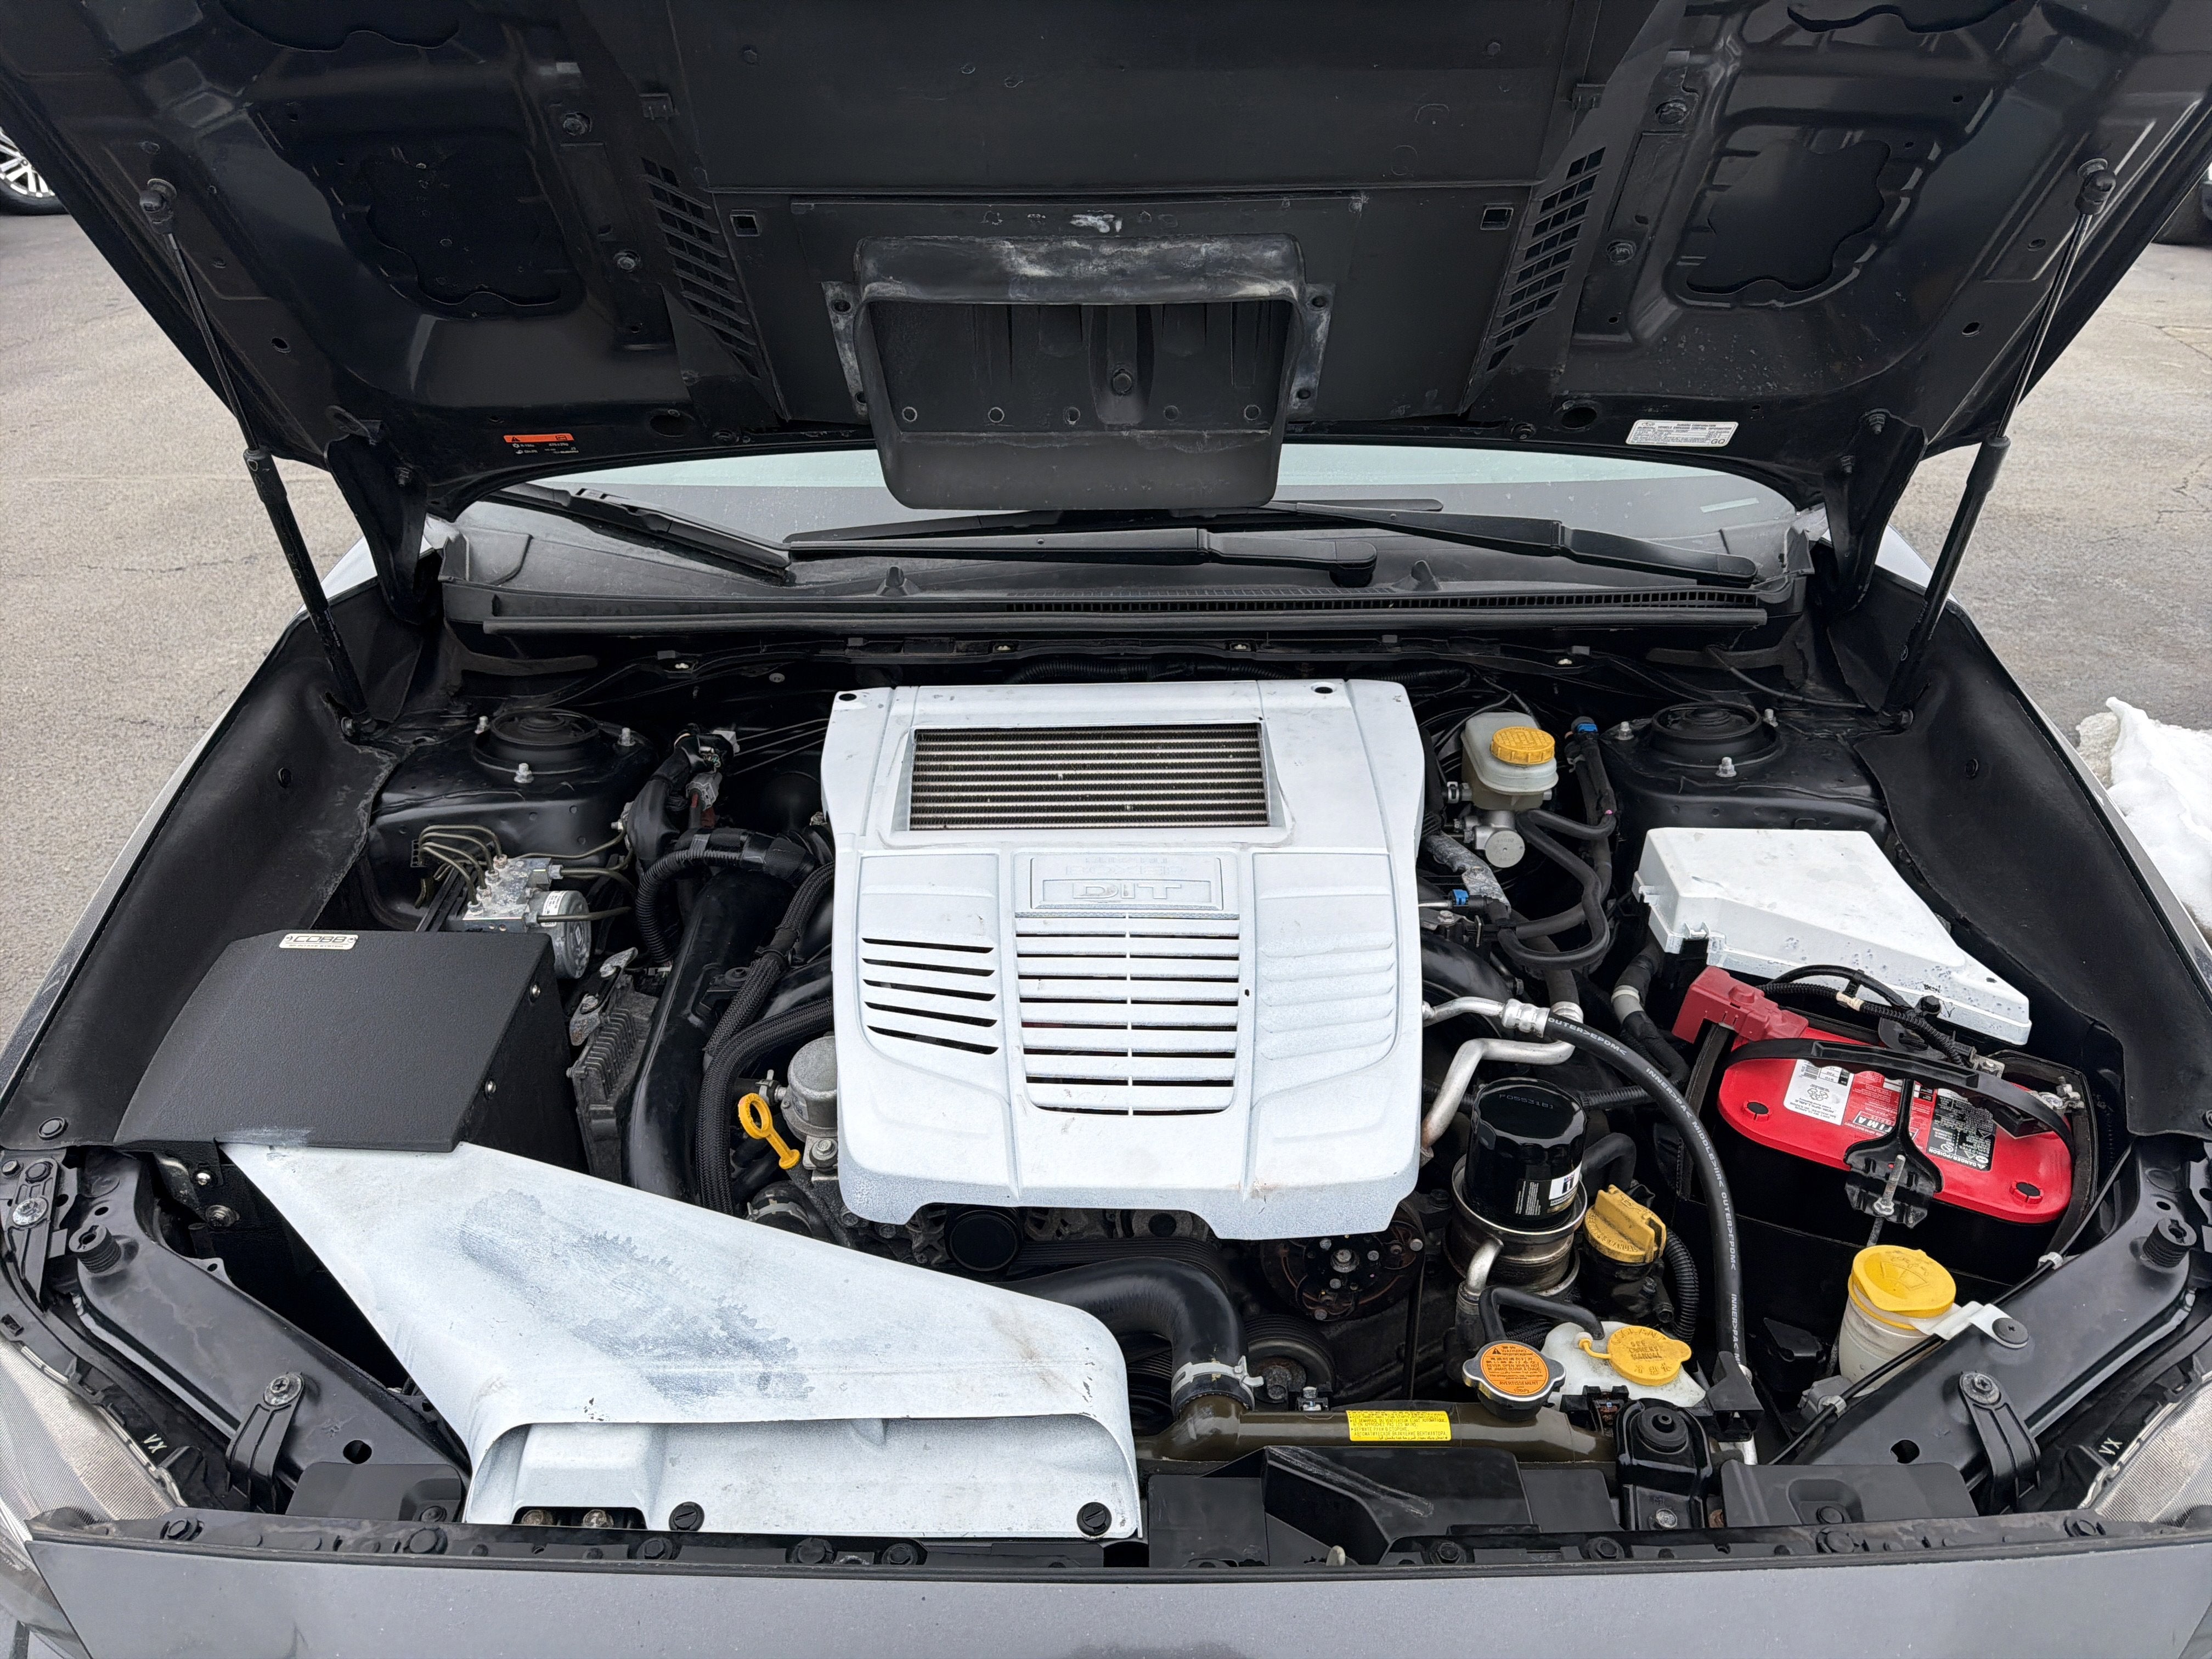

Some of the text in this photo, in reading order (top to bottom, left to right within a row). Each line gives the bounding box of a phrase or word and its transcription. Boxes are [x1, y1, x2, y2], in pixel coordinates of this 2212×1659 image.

[1073, 882, 1181, 900] DIT
[1928, 1148, 1977, 1166] DANGER/POISON
[1607, 1240, 1638, 1252] MANUAL
[1631, 1352, 1662, 1360] MANUAL
